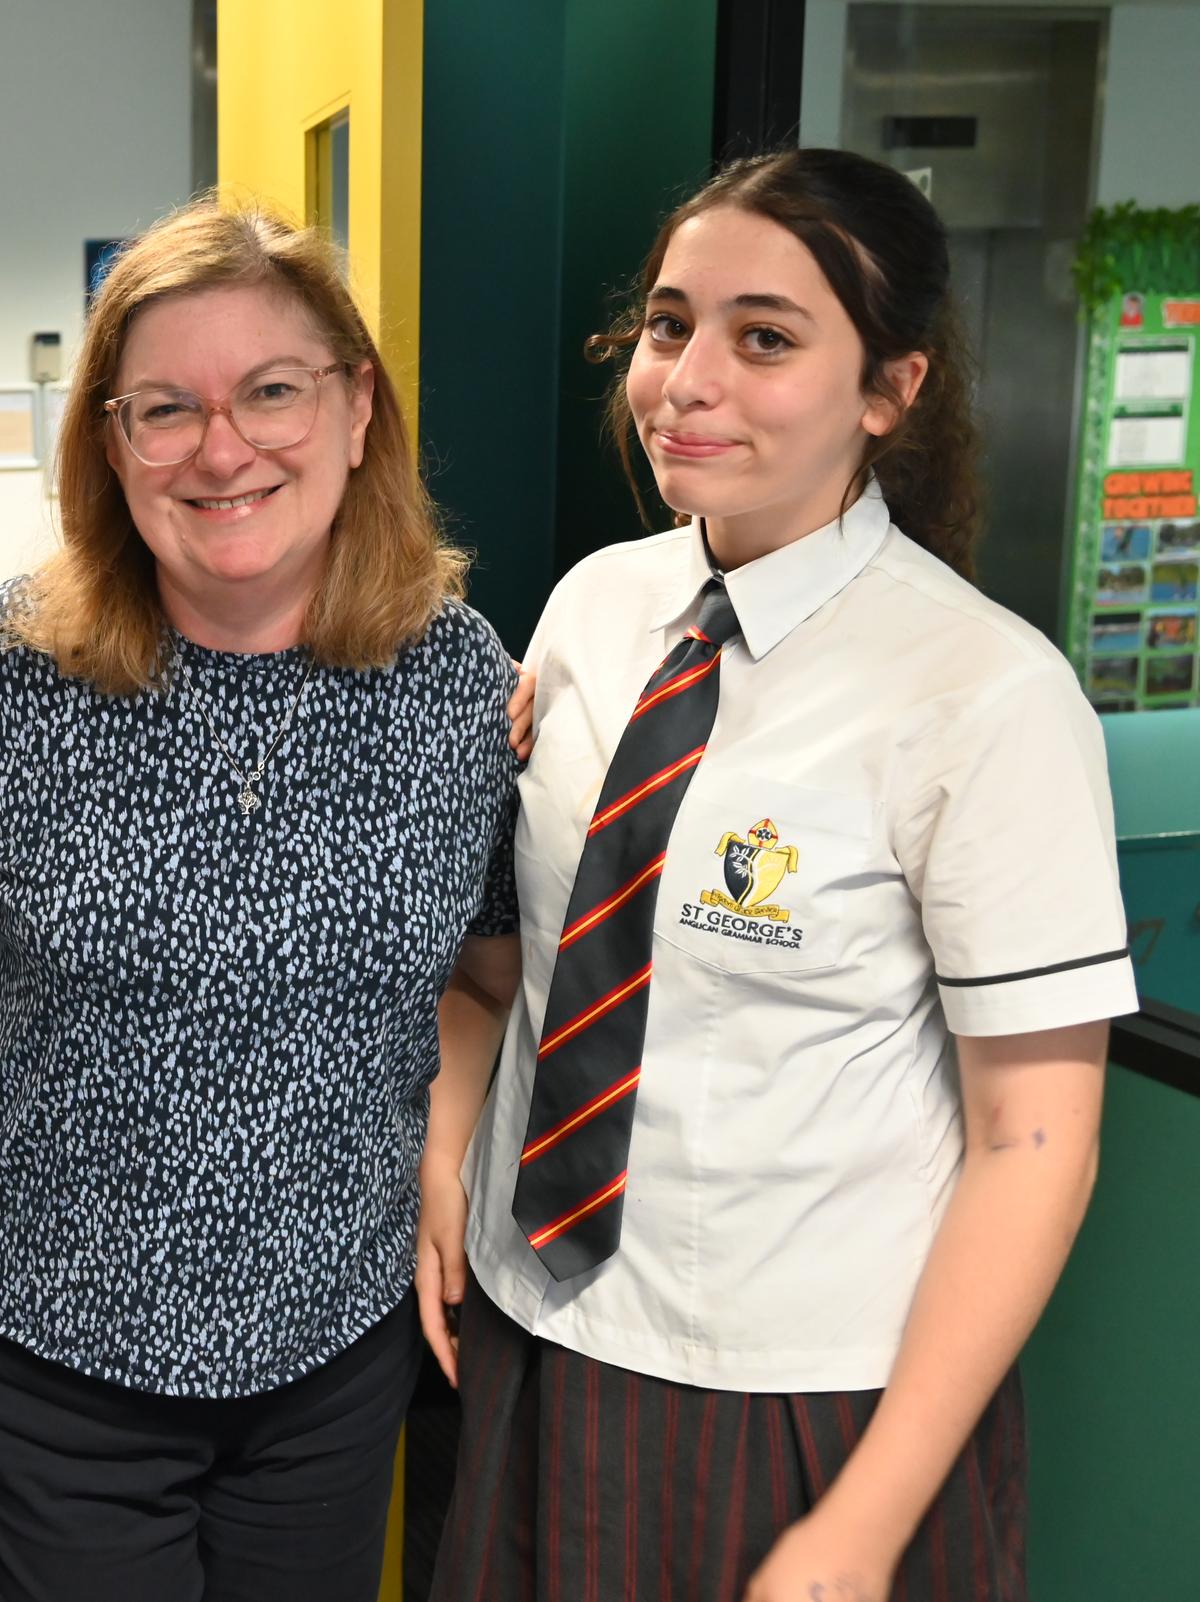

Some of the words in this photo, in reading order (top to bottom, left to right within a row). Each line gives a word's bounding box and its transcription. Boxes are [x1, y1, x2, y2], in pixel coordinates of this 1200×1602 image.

[680, 918, 719, 933] ANGLICAN
[721, 928, 763, 944] GRAMMAR
[765, 938, 800, 949] SCHOOL
[681, 903, 703, 920] ST
[707, 911, 803, 941] GEORGE'S
